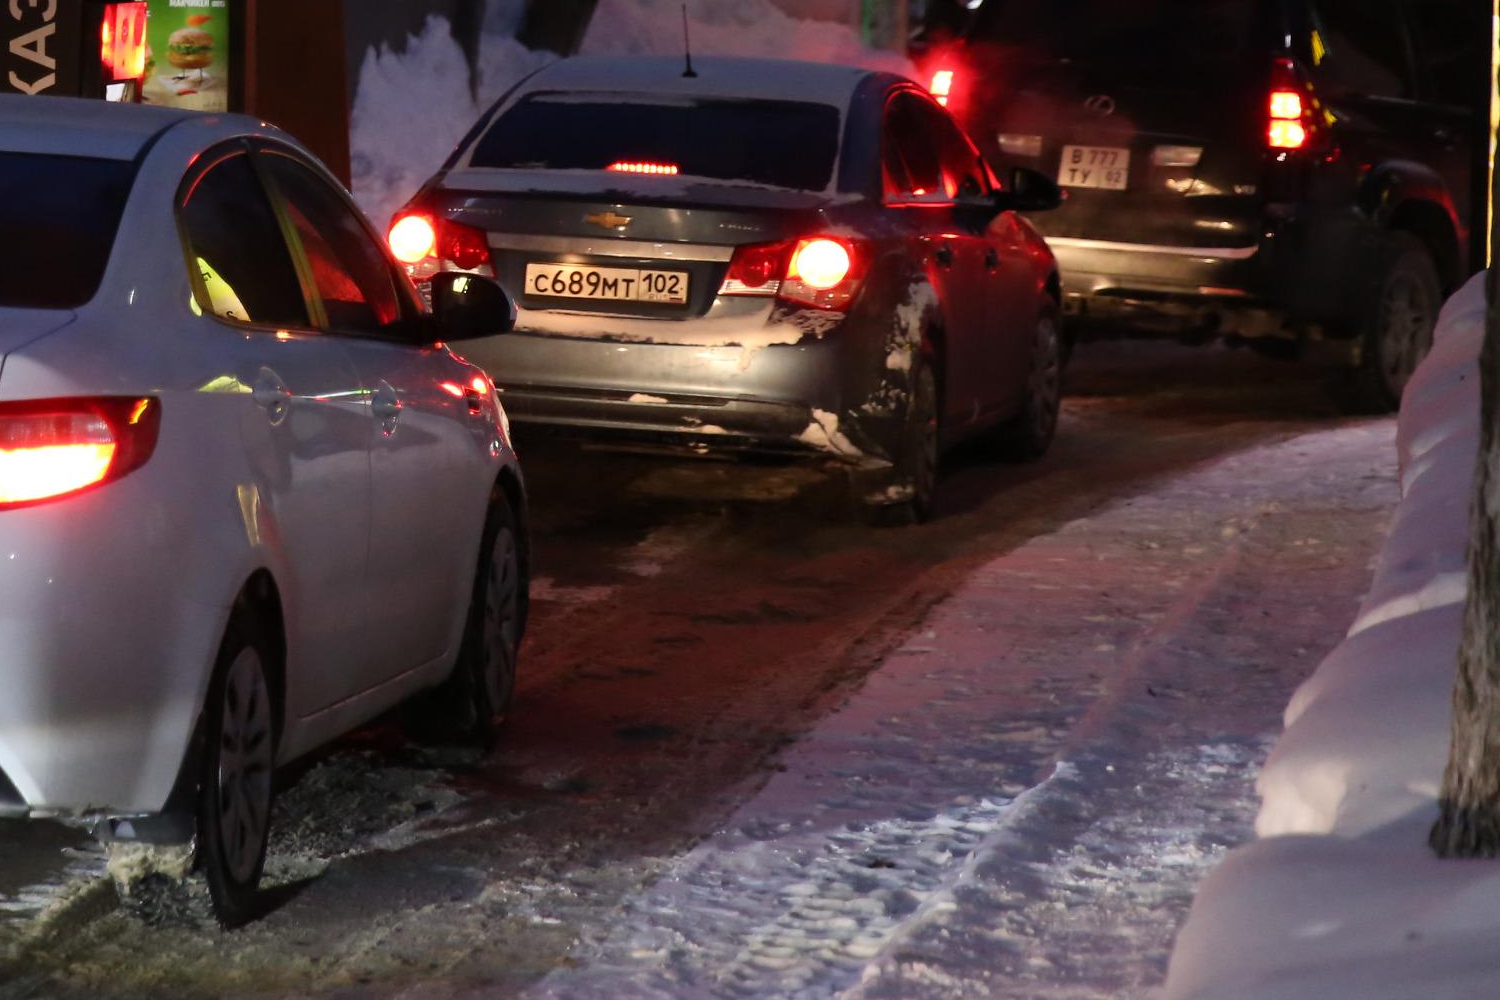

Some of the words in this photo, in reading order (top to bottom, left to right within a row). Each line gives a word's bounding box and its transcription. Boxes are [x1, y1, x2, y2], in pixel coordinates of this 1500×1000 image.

[1089, 149, 1118, 166] 777
[534, 270, 635, 297] С689МТ
[642, 273, 680, 294] 102
